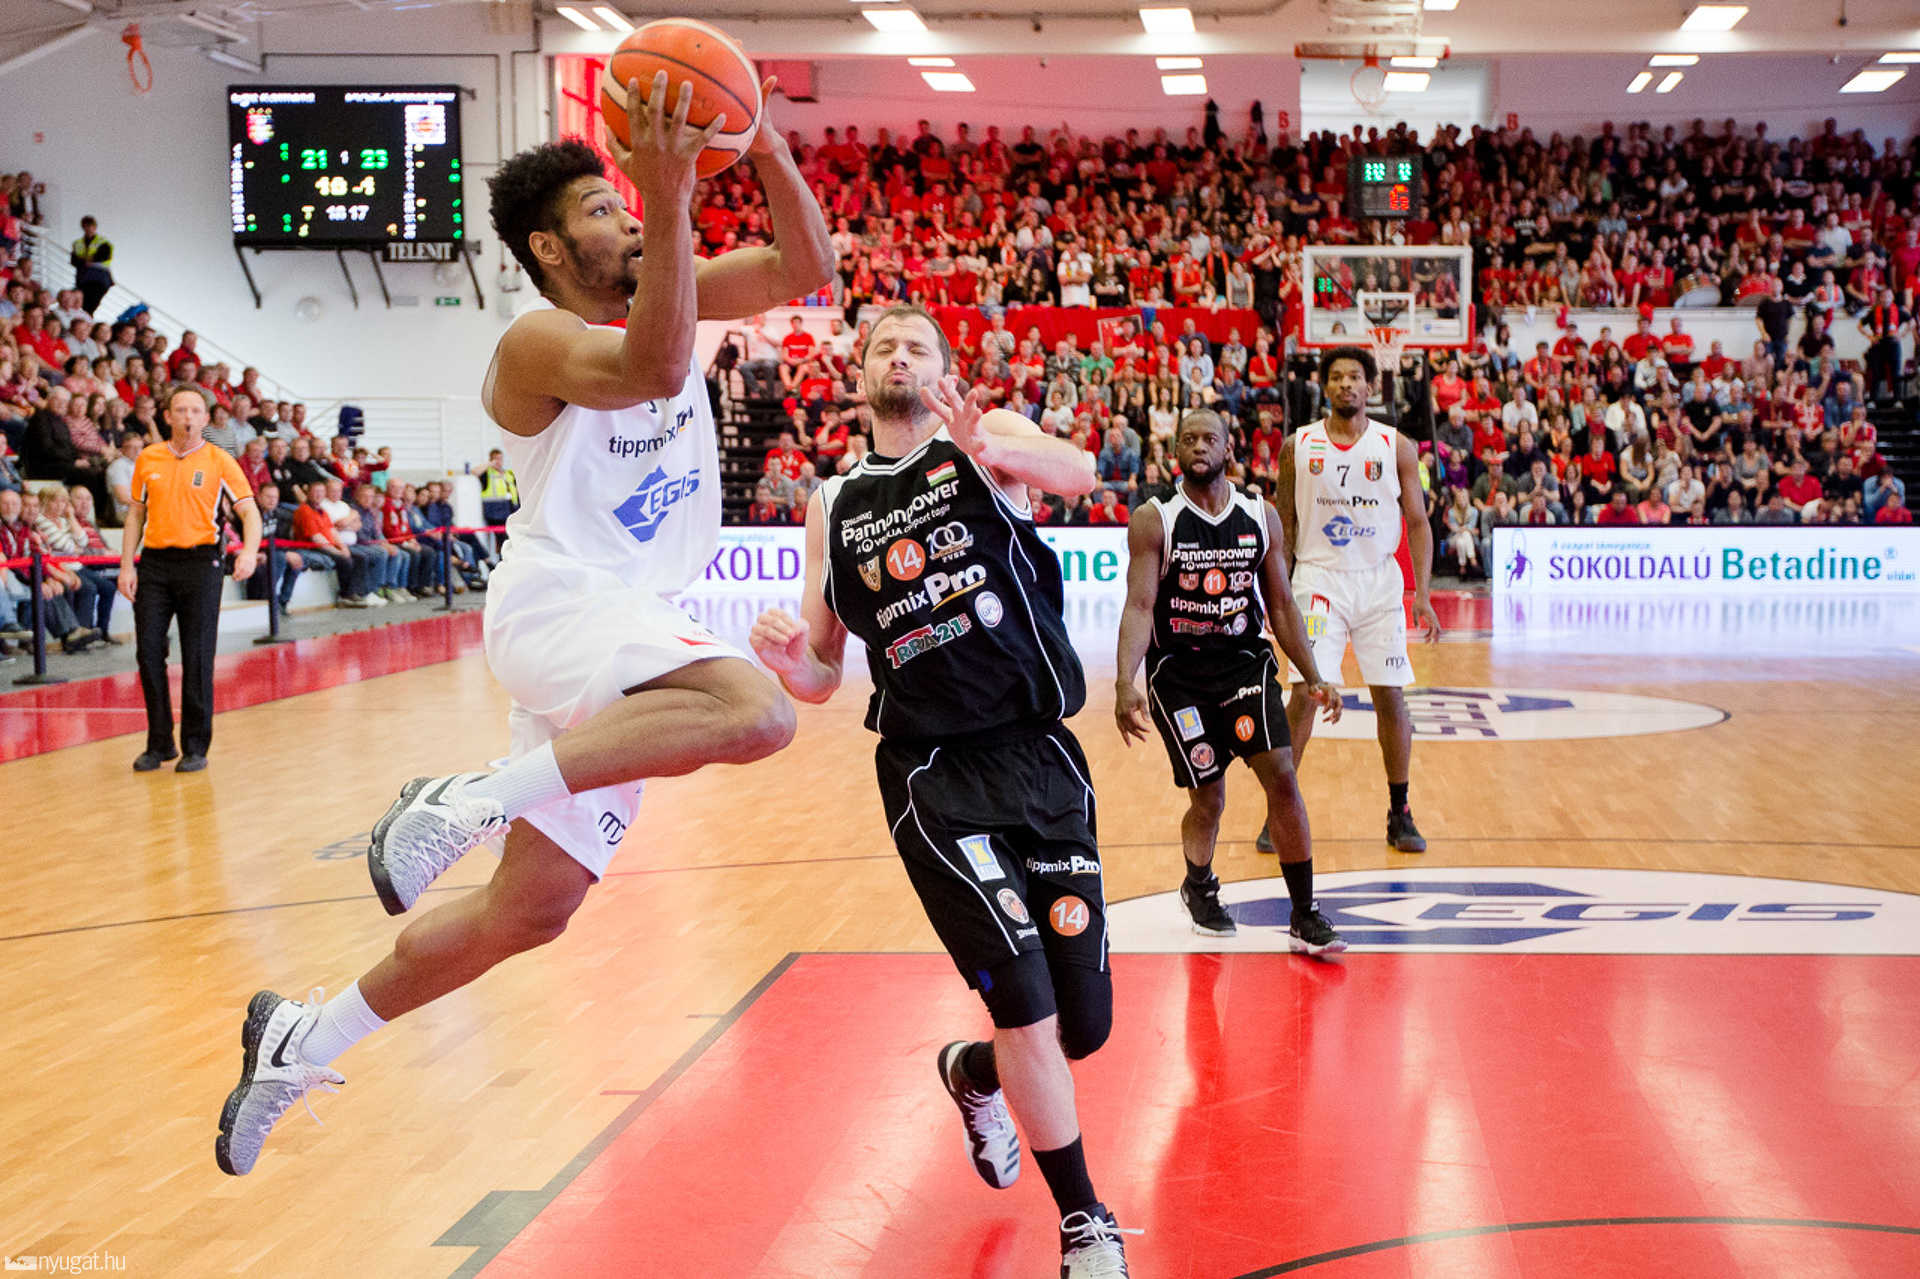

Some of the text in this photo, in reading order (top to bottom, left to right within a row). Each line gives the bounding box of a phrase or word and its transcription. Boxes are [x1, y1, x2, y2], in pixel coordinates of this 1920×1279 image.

[360, 149, 389, 170] 23
[1336, 465, 1351, 487] 7
[889, 543, 922, 575] 14
[1549, 547, 1711, 580] SOKOLDALÚ
[1207, 573, 1222, 591] 11
[1237, 718, 1251, 738] 11
[1053, 902, 1085, 930] 14
[1416, 903, 1882, 921] EGIS
